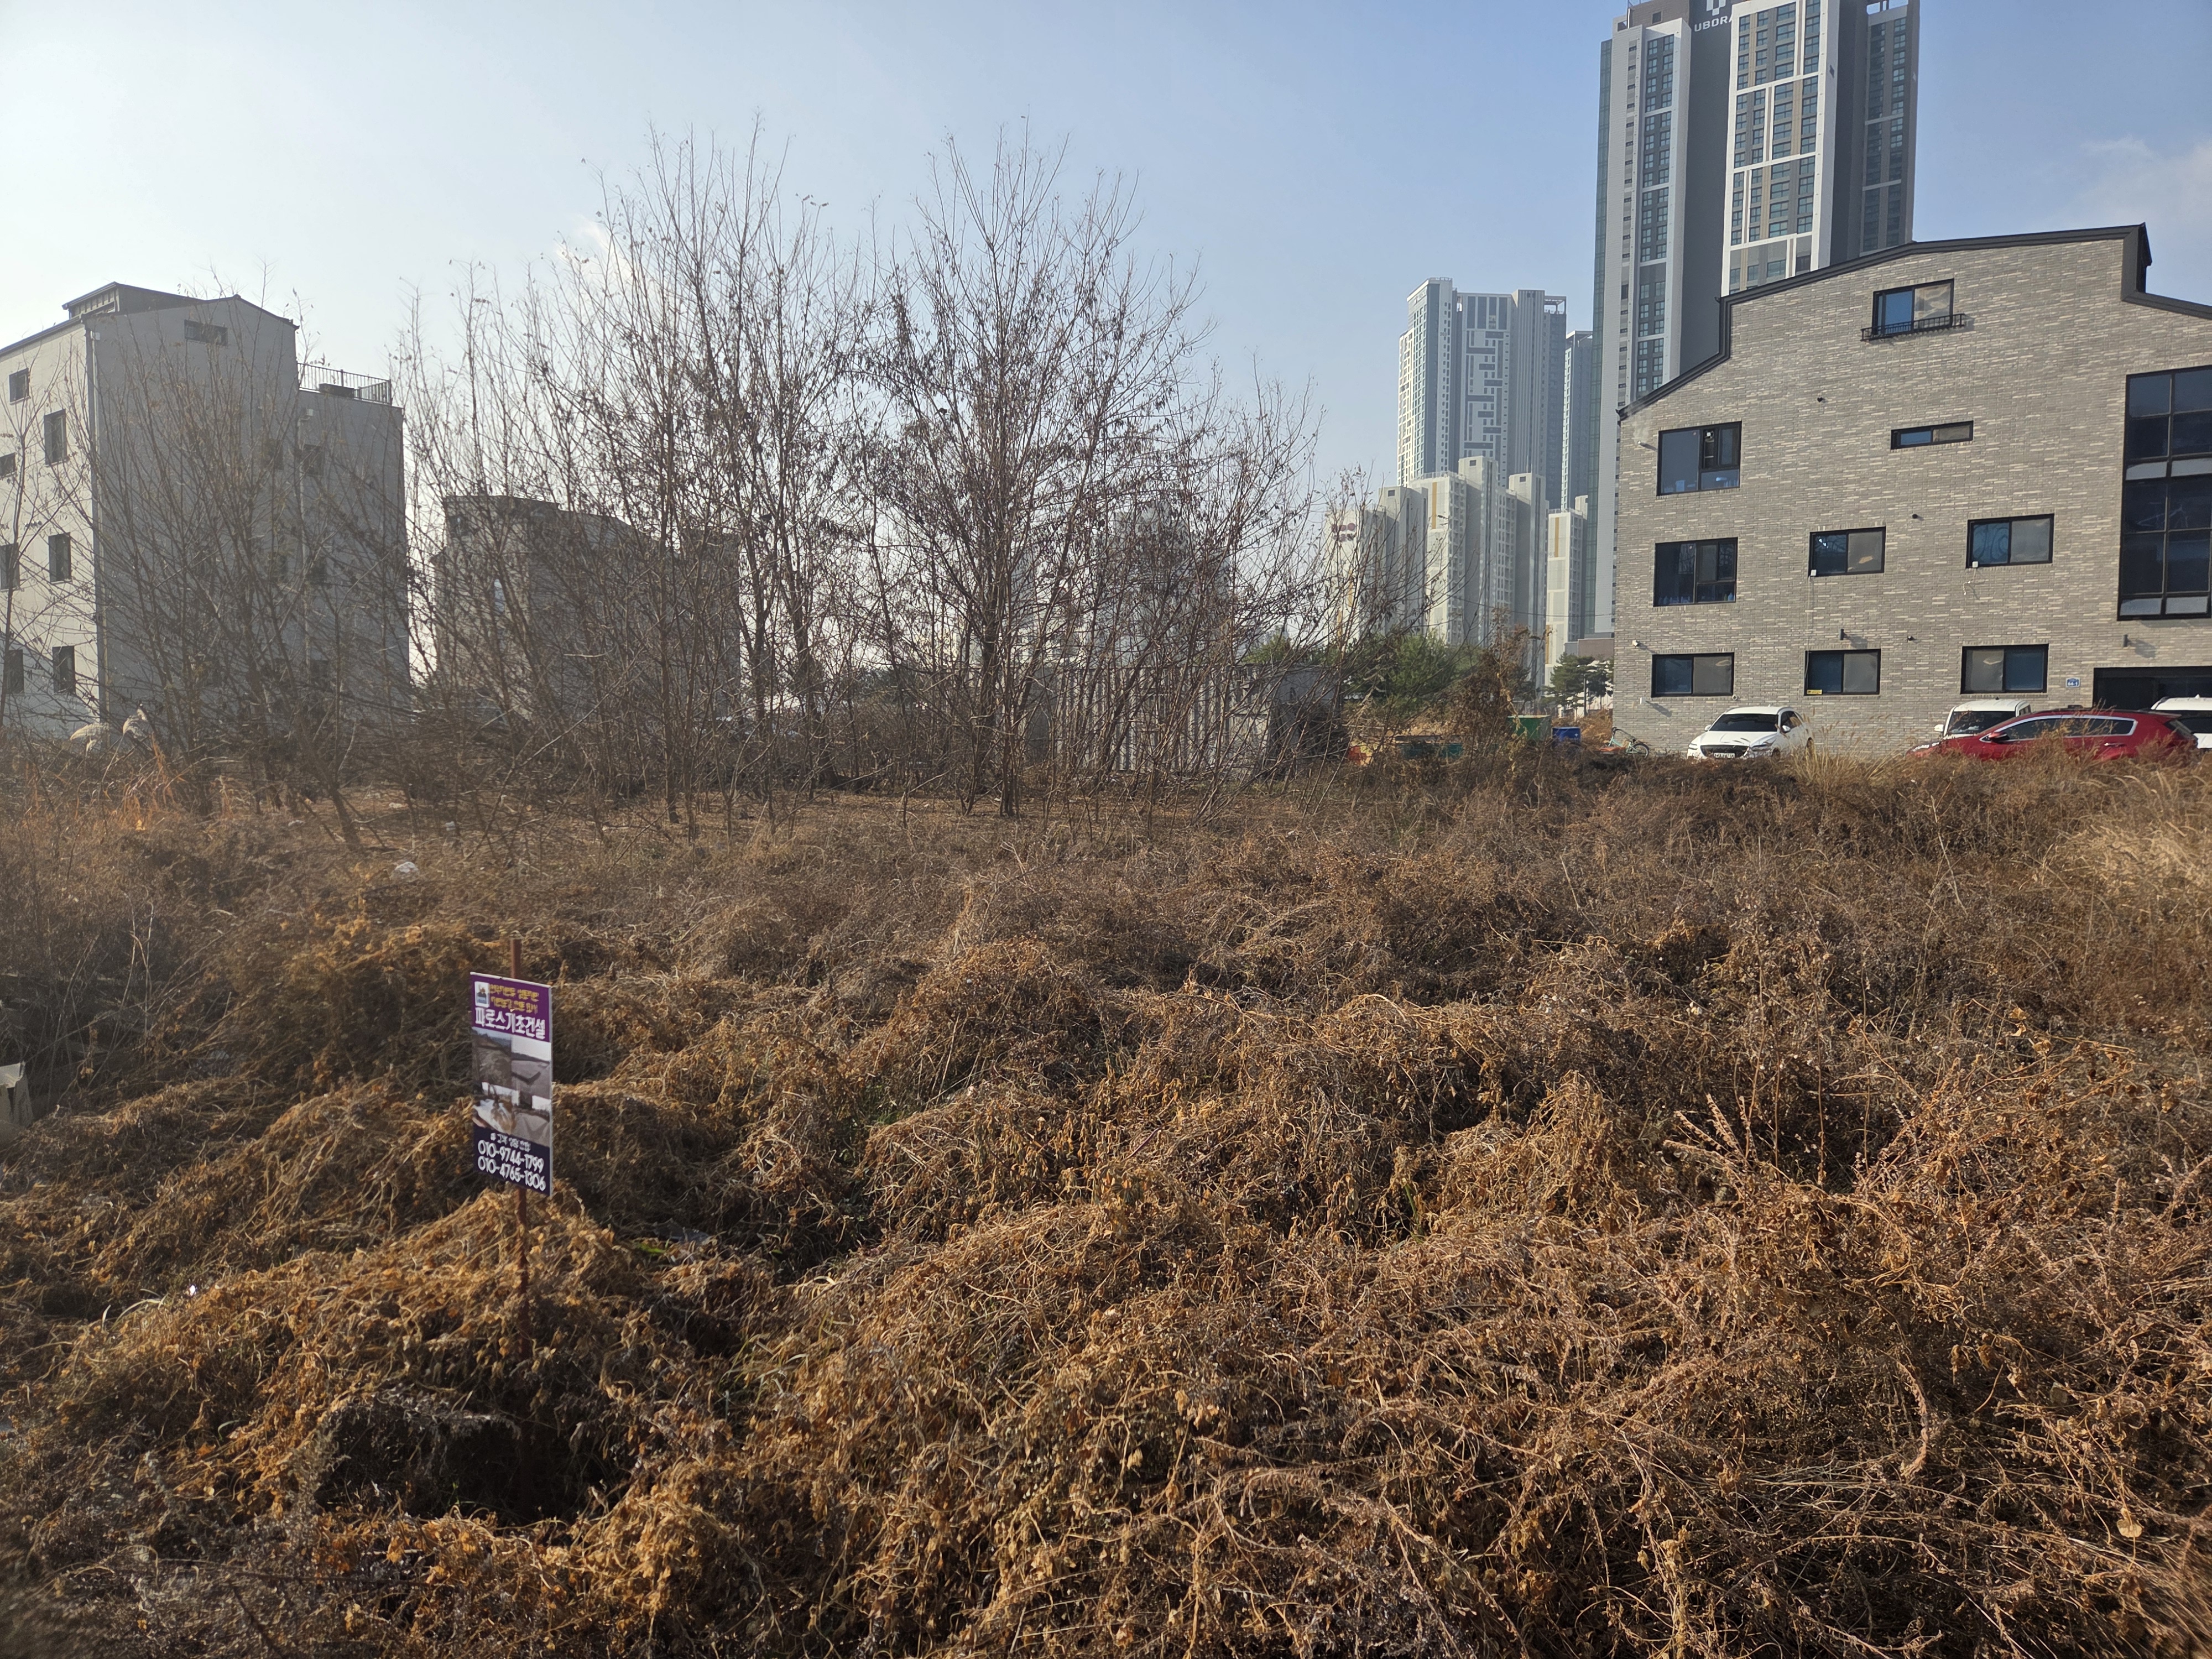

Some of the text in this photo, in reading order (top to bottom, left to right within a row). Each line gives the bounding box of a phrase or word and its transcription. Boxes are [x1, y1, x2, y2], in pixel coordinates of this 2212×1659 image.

[475, 1007, 545, 1040] 파로스기초건설
[478, 1140, 544, 1173] 010-9744-1799
[478, 1156, 546, 1191] 010-4765-1306
